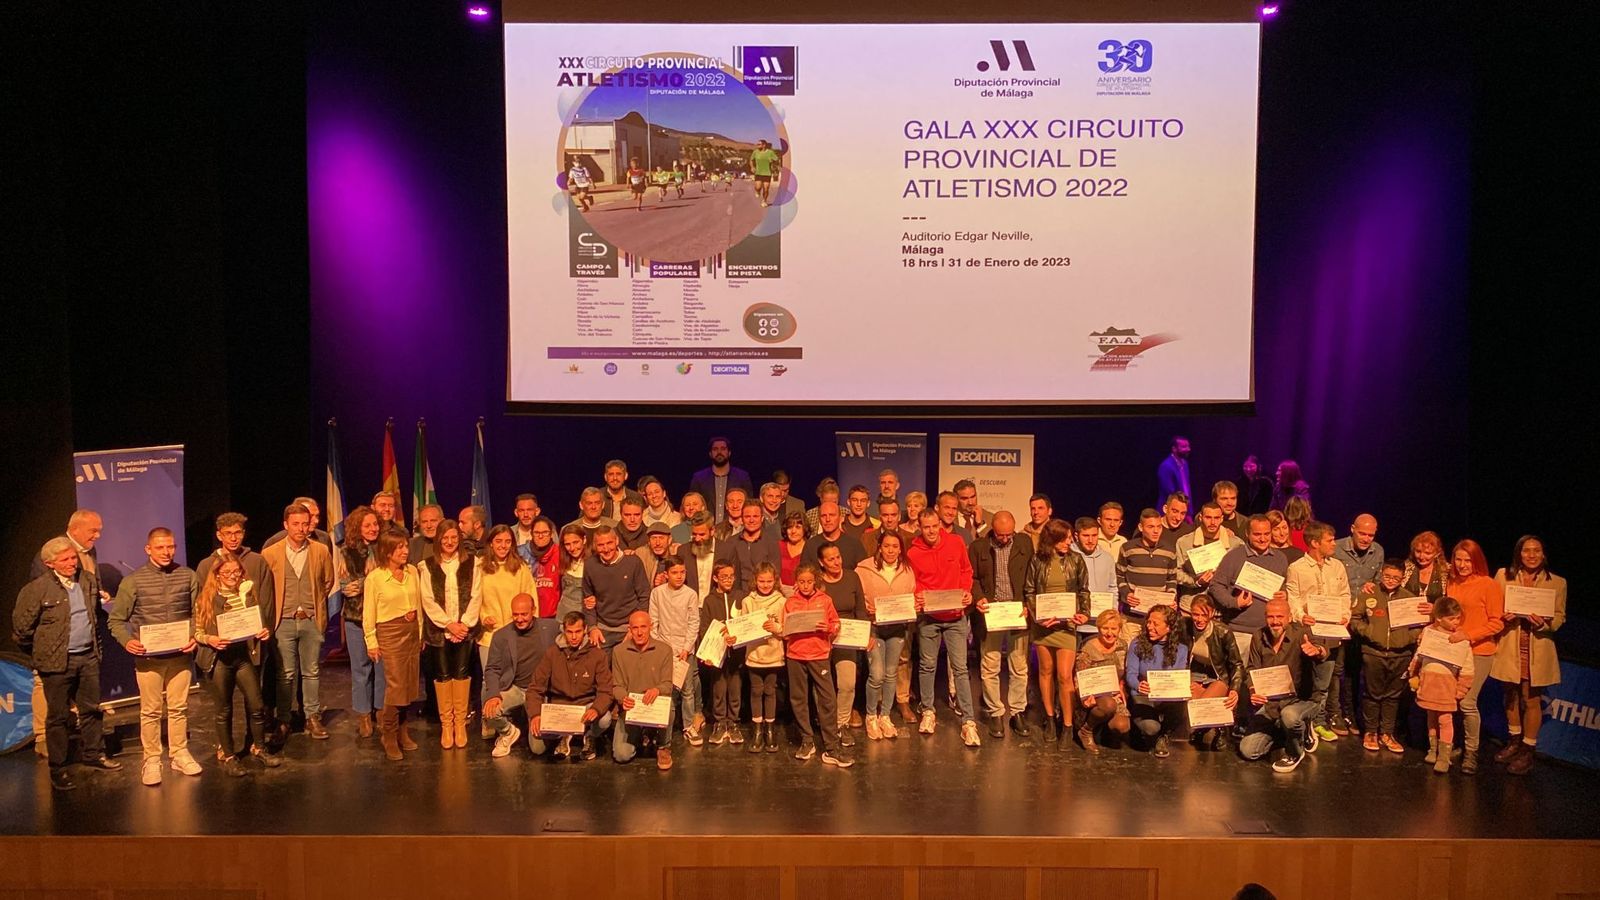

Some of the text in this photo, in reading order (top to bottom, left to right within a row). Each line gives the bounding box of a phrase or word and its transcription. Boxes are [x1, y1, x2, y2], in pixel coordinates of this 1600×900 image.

[559, 57, 725, 69] XXX CIRCUITO PROVINCIAL
[557, 72, 726, 88] ATLETISMO 2022
[954, 77, 1061, 88] Diputación Provincial
[981, 88, 1034, 99] de Málaga
[904, 118, 1184, 140] GALA XXX CIRCUITO
[904, 149, 1117, 169] PROVINCIAL DE
[902, 178, 1128, 199] ATLETISMO 2022
[902, 230, 1033, 244] Auditorio Edgar Neville,
[901, 243, 944, 256] Málaga
[902, 258, 916, 268] 18
[918, 258, 938, 268] hrs
[948, 258, 962, 268] 31
[965, 258, 981, 268] de
[984, 258, 1020, 268] Enero
[1023, 257, 1039, 268] de
[1041, 257, 1071, 267] 2023
[954, 451, 1017, 464] DECATHLON
